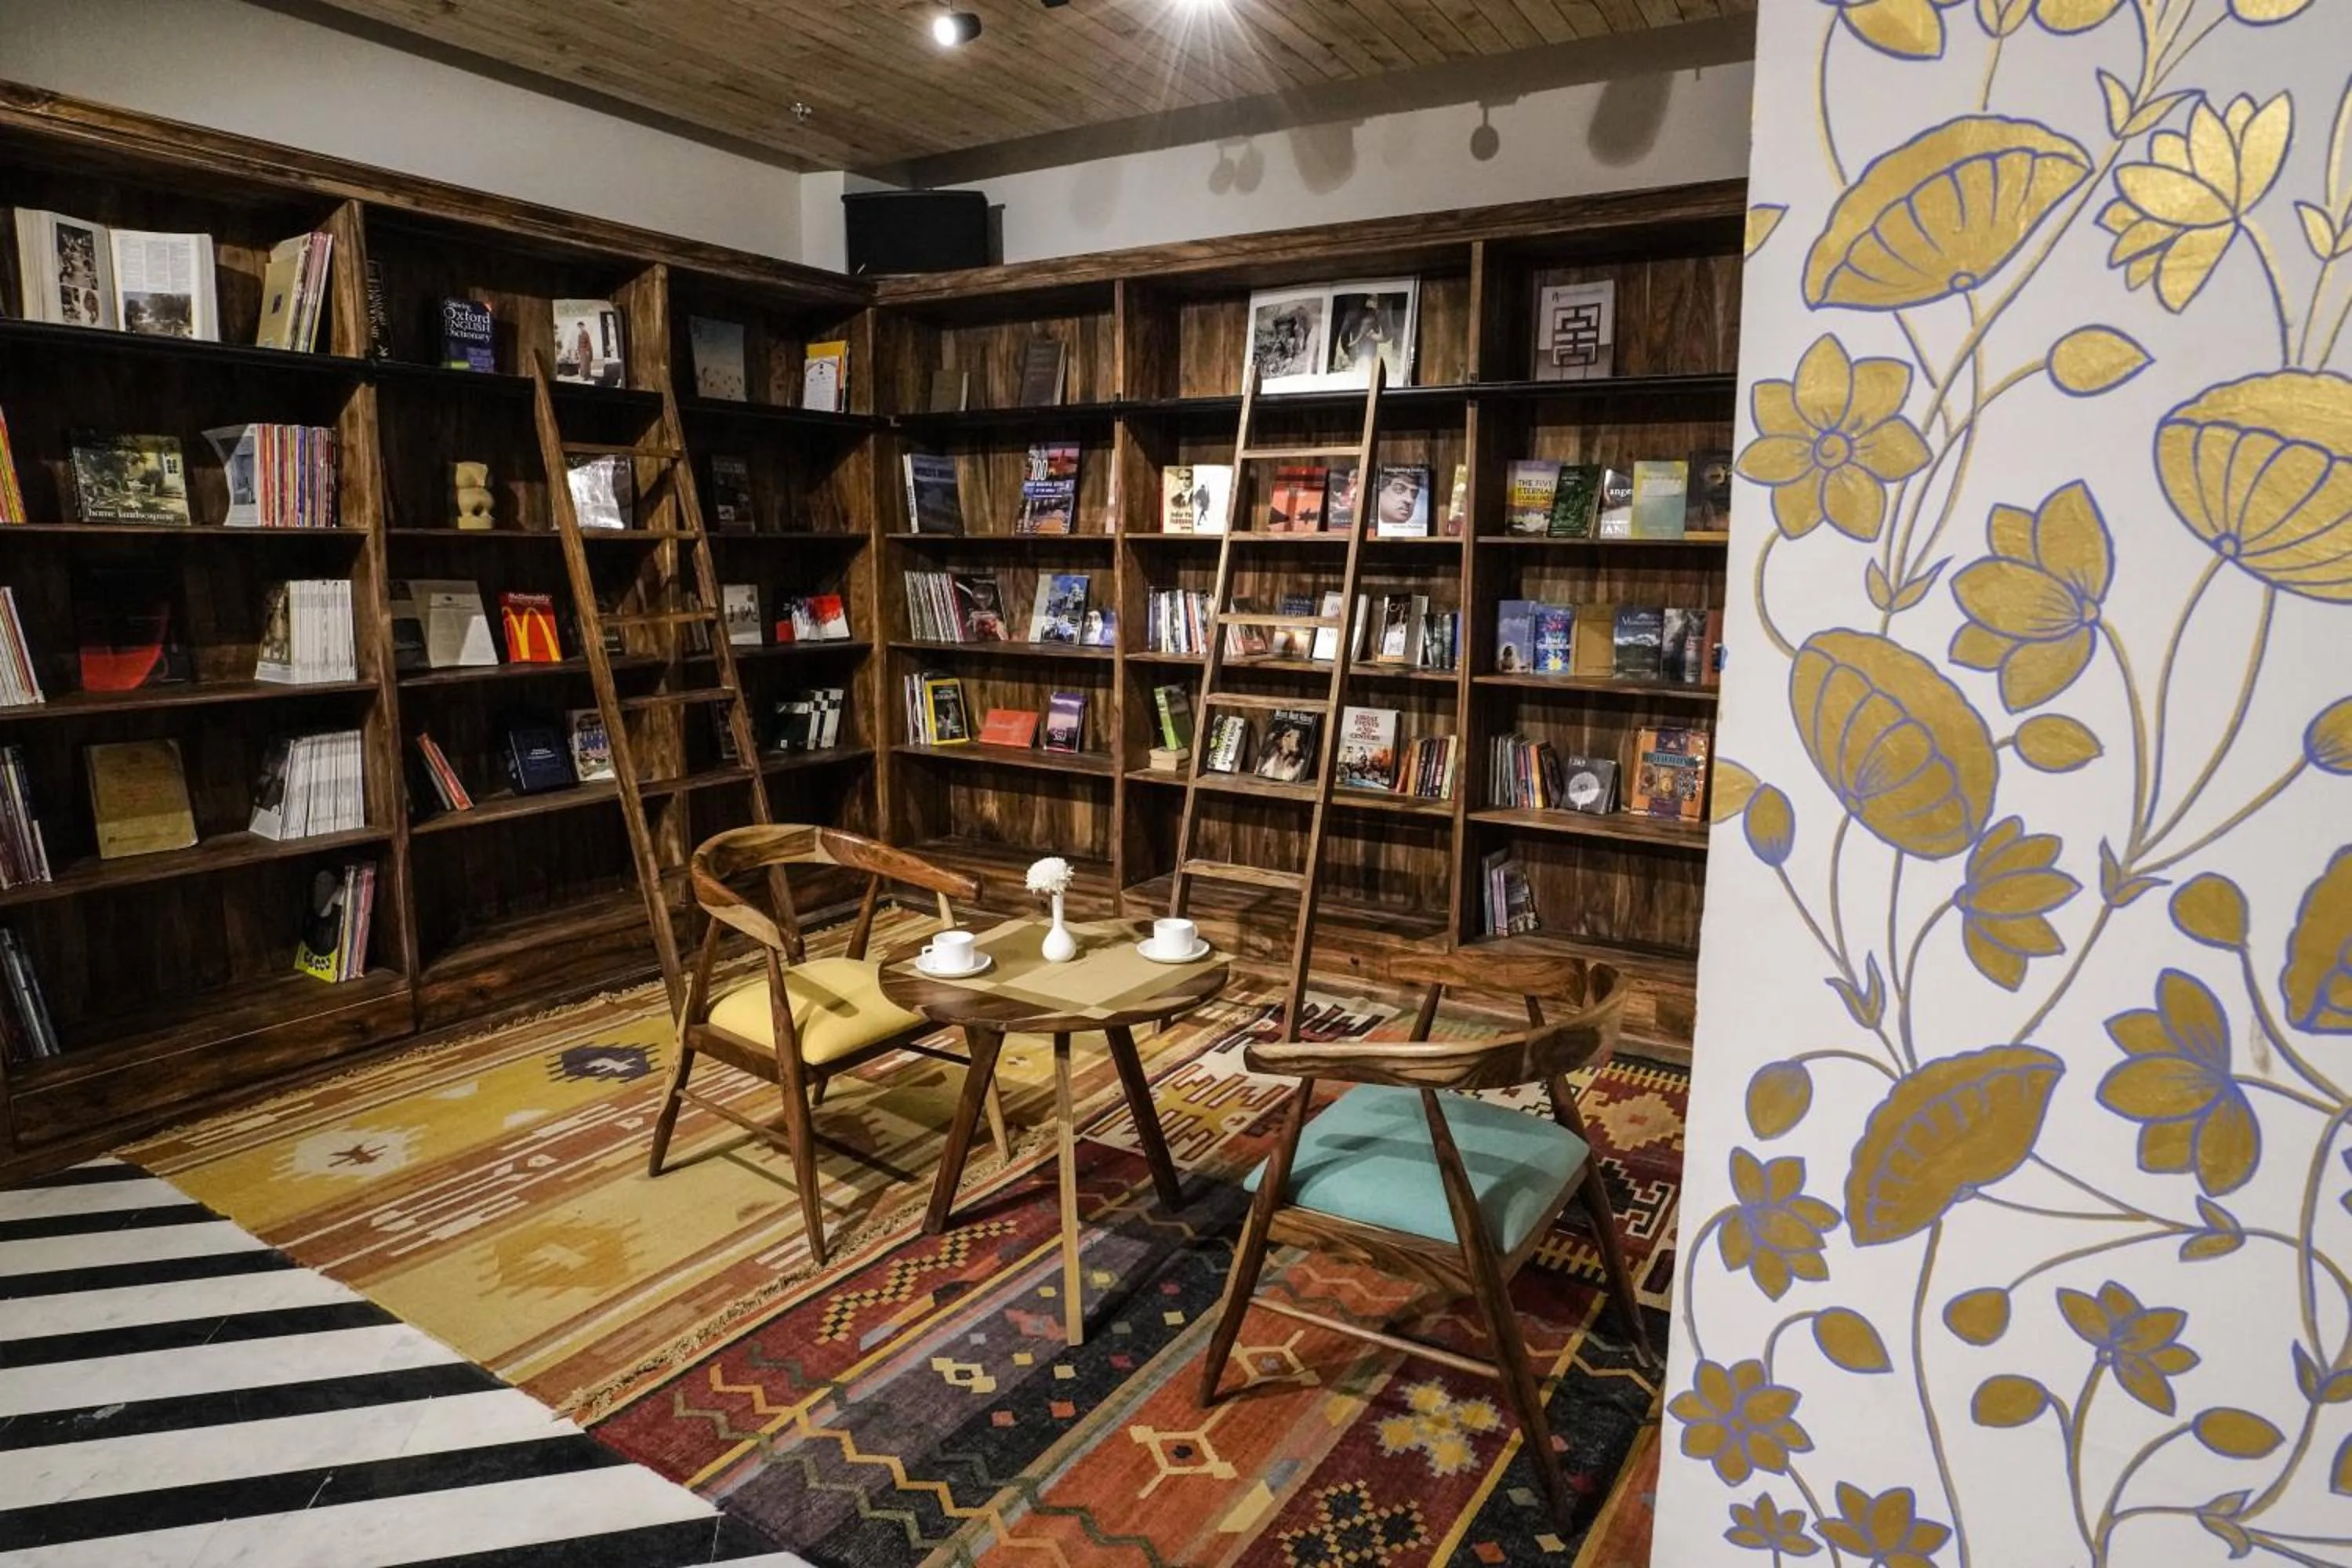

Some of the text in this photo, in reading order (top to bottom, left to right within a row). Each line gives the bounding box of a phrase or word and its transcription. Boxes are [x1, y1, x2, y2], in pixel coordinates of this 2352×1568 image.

[443, 307, 490, 324] Oxford
[445, 319, 490, 332] ENGLISH
[445, 328, 490, 342] Dictionary
[1610, 488, 1632, 497] ange
[89, 507, 114, 517] home
